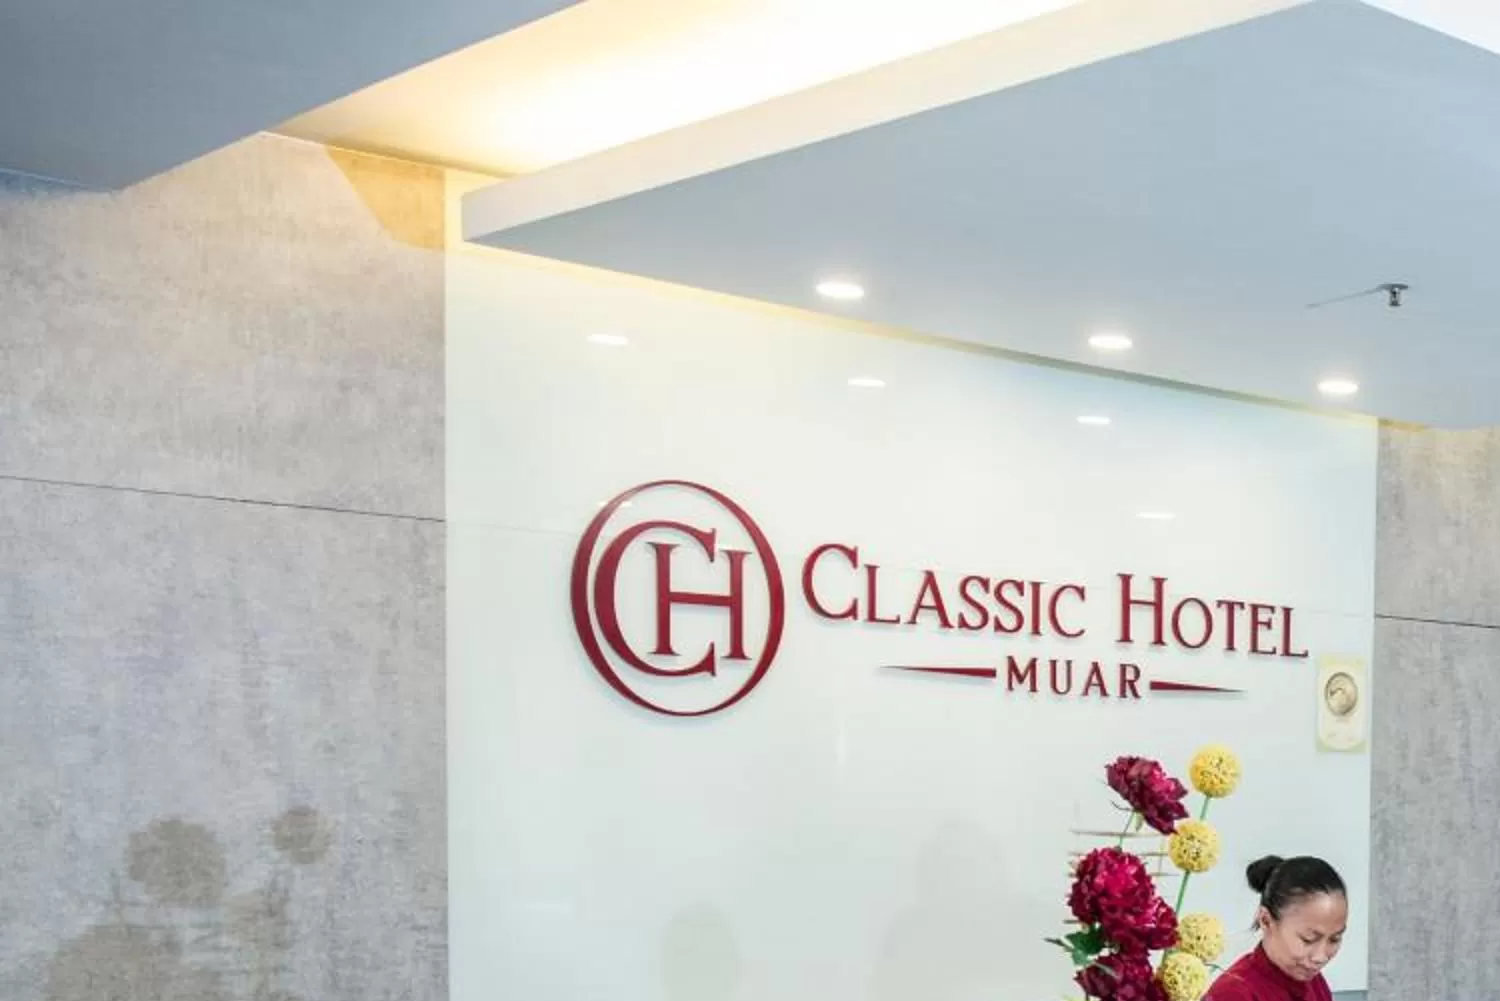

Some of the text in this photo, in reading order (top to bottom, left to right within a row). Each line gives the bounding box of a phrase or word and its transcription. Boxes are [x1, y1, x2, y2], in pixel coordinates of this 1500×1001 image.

[802, 544, 1310, 659] CLASSIC HOTEL
[1006, 656, 1143, 700] MUAR
